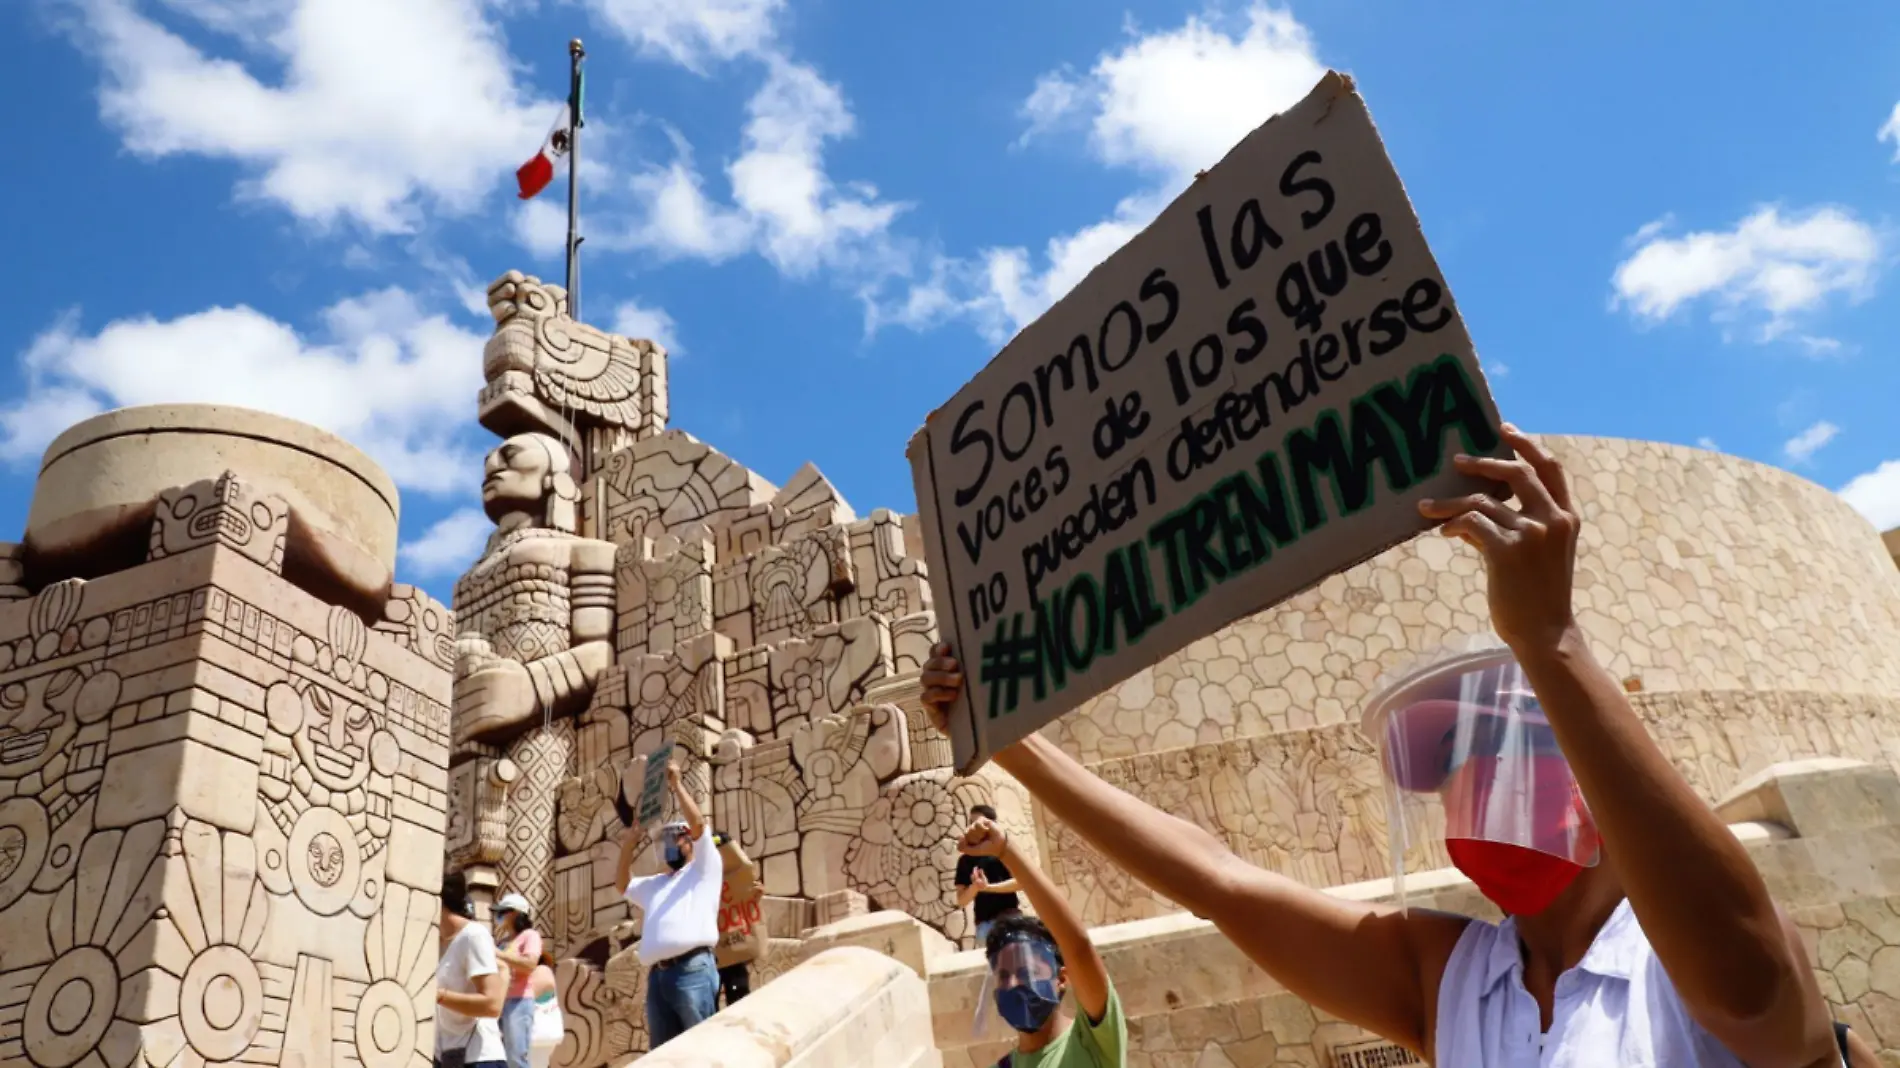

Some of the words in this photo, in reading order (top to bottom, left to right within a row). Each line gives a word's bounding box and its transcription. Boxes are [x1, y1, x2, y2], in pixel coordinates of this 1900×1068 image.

[950, 267, 1179, 507] Somos
[1196, 150, 1336, 290] las
[957, 445, 1070, 565] voces
[1093, 390, 1151, 460] de
[1165, 298, 1268, 406] los
[1275, 212, 1393, 334] que
[968, 571, 1008, 631] no
[1022, 457, 1156, 611] pueden
[1166, 278, 1453, 482] defenderse
